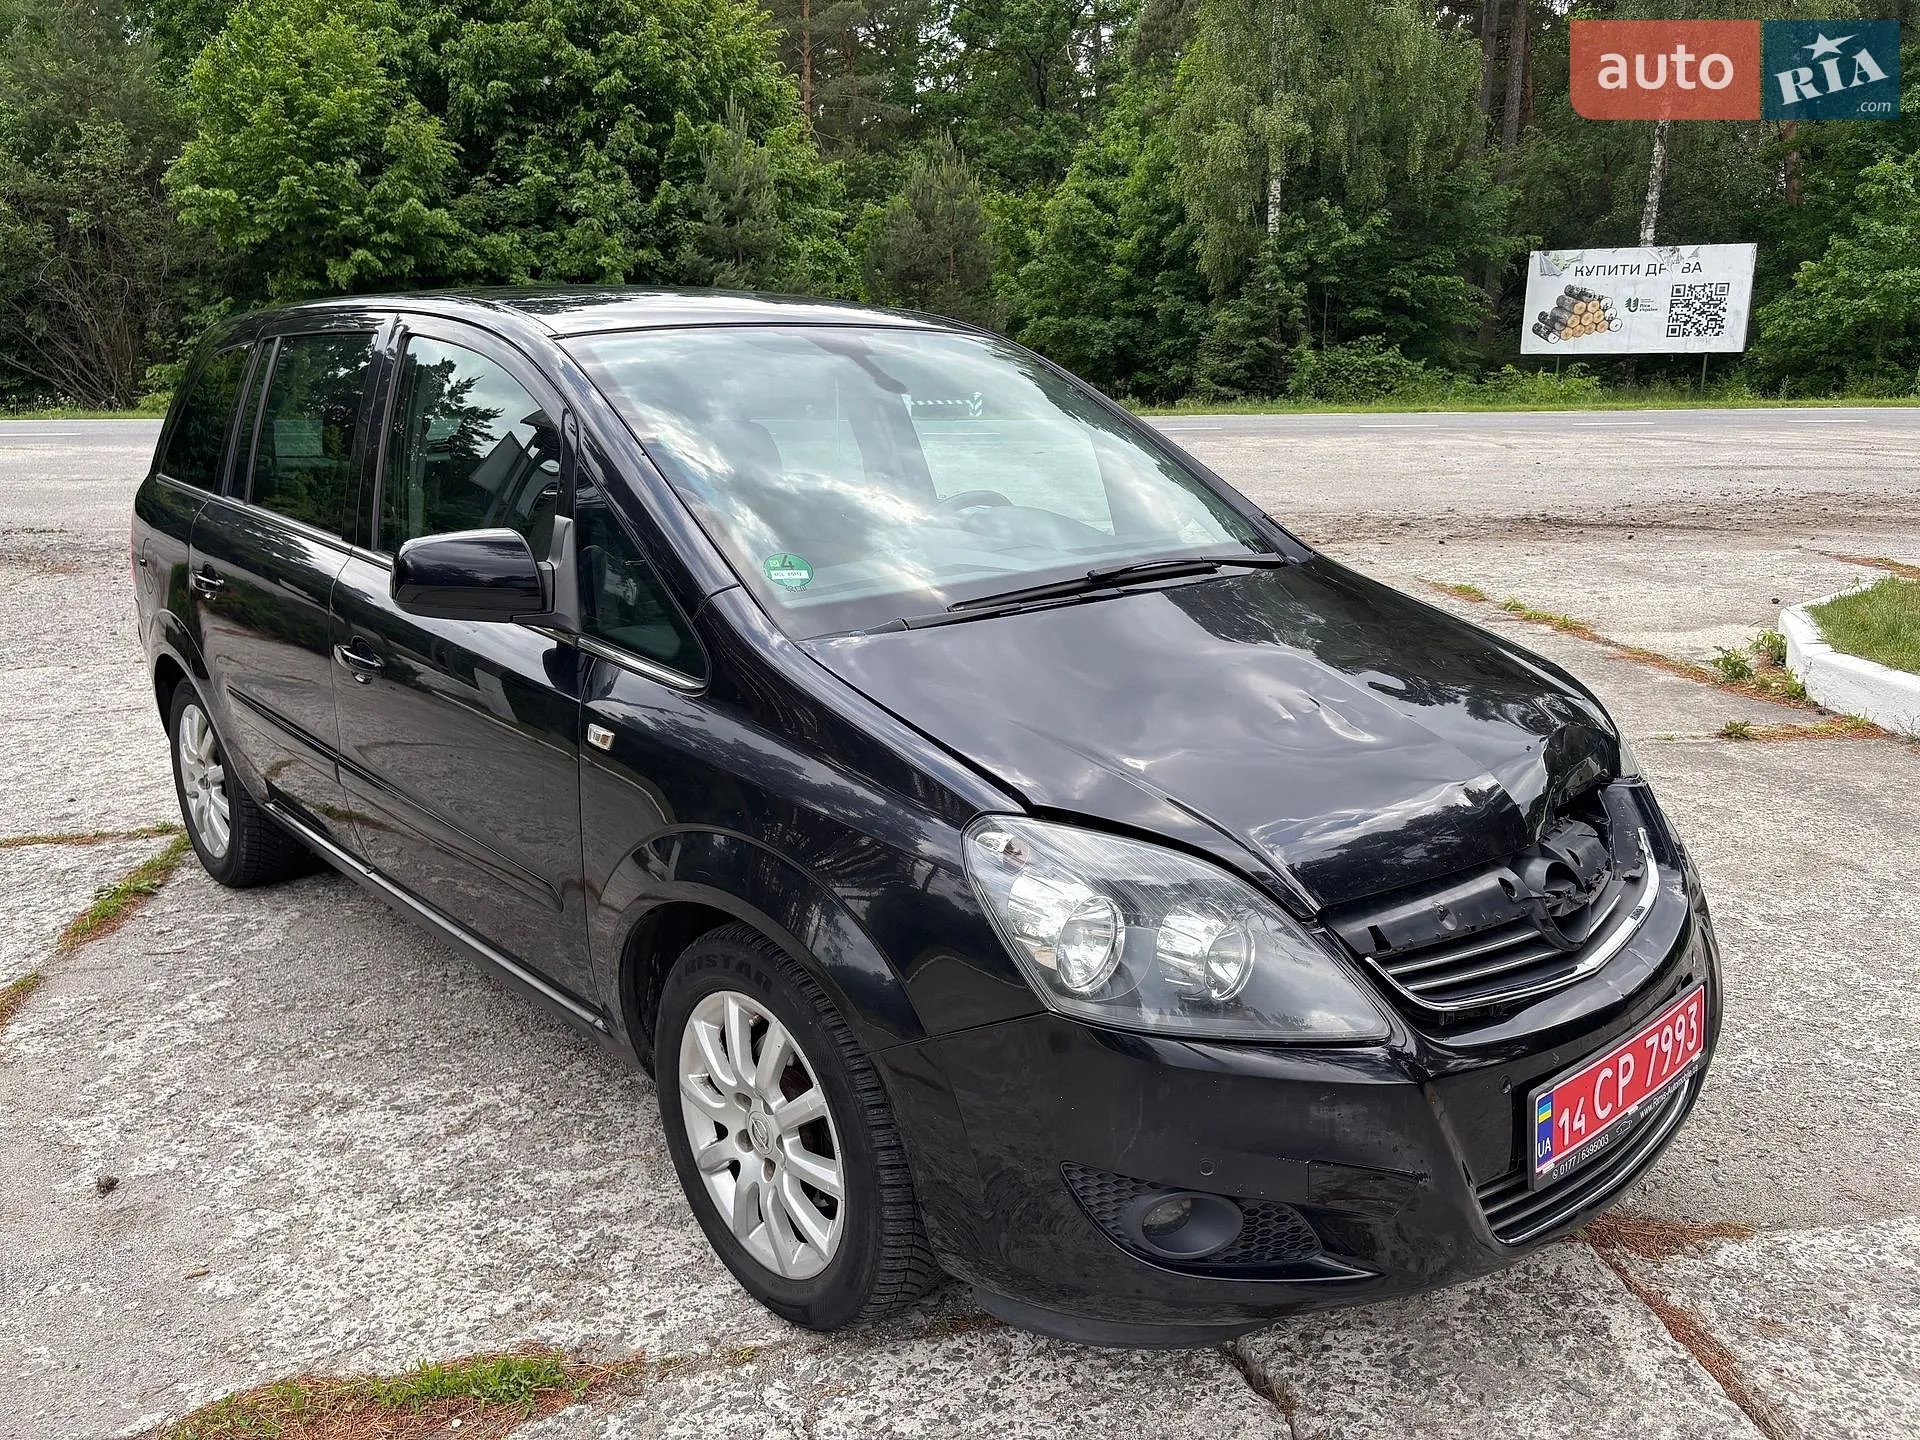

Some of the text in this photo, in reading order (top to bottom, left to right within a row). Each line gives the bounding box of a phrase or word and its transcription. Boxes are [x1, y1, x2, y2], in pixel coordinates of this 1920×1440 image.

[1574, 261, 1703, 277] КУПИТИ ДРВА
[1558, 1001, 1699, 1147] 14 CP 7993
[1537, 1137, 1552, 1158] UA
